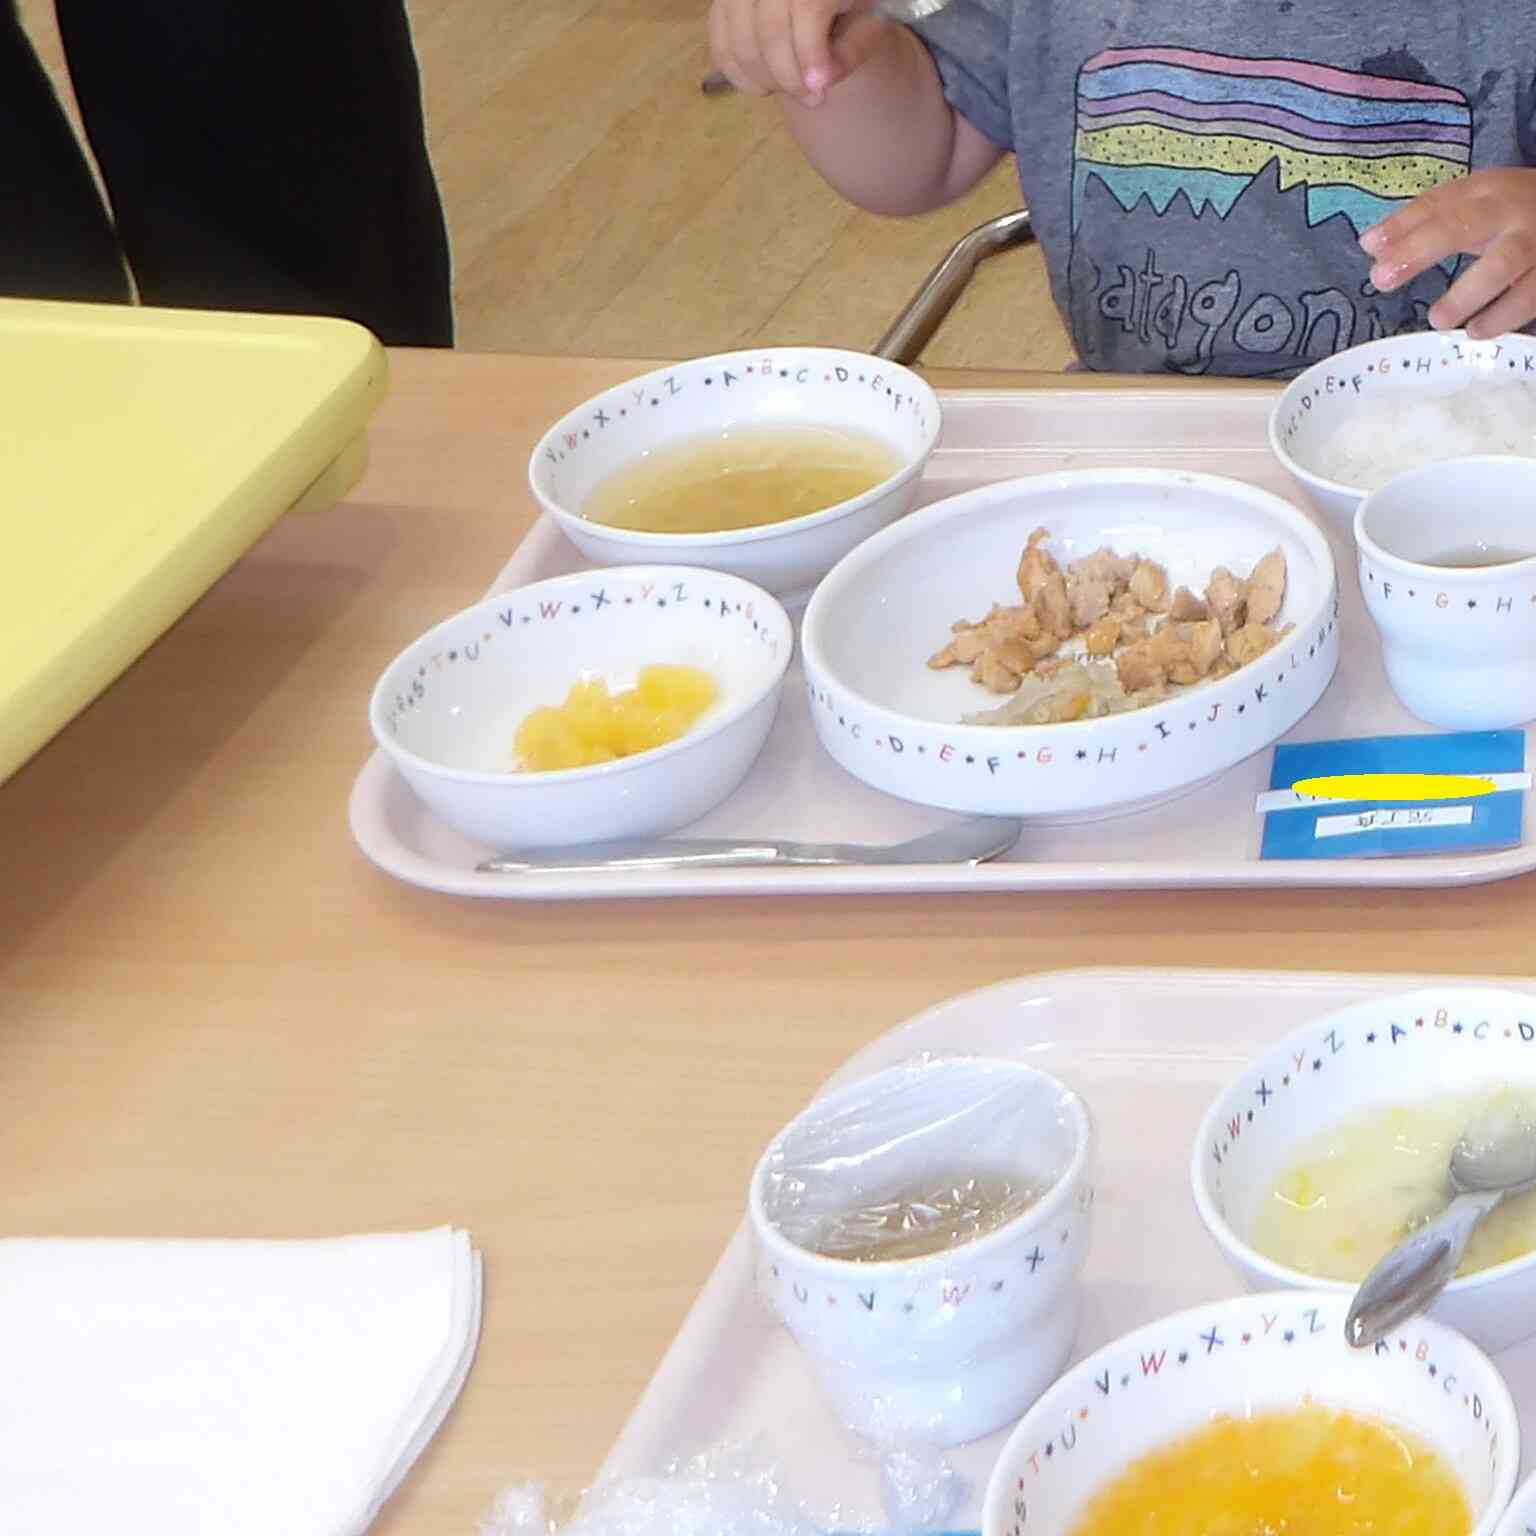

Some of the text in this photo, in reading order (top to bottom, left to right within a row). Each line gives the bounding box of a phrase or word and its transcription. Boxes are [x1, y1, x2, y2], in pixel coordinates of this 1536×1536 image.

[1076, 248, 1432, 375] atagoni
[593, 409, 610, 428] X
[664, 376, 681, 395] Z
[723, 371, 738, 387] A
[796, 368, 808, 383] C
[835, 367, 848, 382] D
[872, 375, 883, 390] E
[1301, 396, 1311, 410] D
[1352, 374, 1362, 393] F
[1378, 357, 1392, 374] G
[1416, 358, 1431, 372] H
[1453, 344, 1464, 359] I
[1491, 344, 1503, 360] J
[1524, 356, 1534, 371] K
[464, 642, 480, 661] U
[499, 608, 512, 627] V
[540, 602, 562, 618] W
[590, 589, 611, 610] X
[641, 584, 655, 600] Y
[673, 583, 688, 602] Z
[1435, 591, 1449, 609] G
[1496, 595, 1513, 612] H
[889, 736, 904, 753] D
[940, 744, 954, 760] E
[987, 756, 1000, 775] F
[1036, 745, 1052, 764] G
[1098, 747, 1117, 763] H
[1155, 721, 1171, 739] I
[1208, 704, 1220, 722] J
[1255, 683, 1268, 703] K
[1227, 1113, 1240, 1140] W
[1255, 1079, 1272, 1106] X
[1294, 1049, 1305, 1073] Y
[1324, 1030, 1344, 1054] Z
[1391, 1024, 1407, 1045] A
[1434, 1009, 1447, 1028] B
[1474, 1021, 1488, 1040] C
[1518, 1021, 1535, 1042] D
[793, 1246, 1044, 1311] U V W X
[1028, 1451, 1040, 1473] T
[1061, 1423, 1077, 1450] U
[1095, 1369, 1109, 1395] V
[1141, 1350, 1166, 1376] W
[1200, 1326, 1224, 1355] X
[1261, 1312, 1278, 1334] Y
[1304, 1309, 1324, 1334] Z
[1415, 1341, 1428, 1360] B
[1442, 1374, 1457, 1393] C
